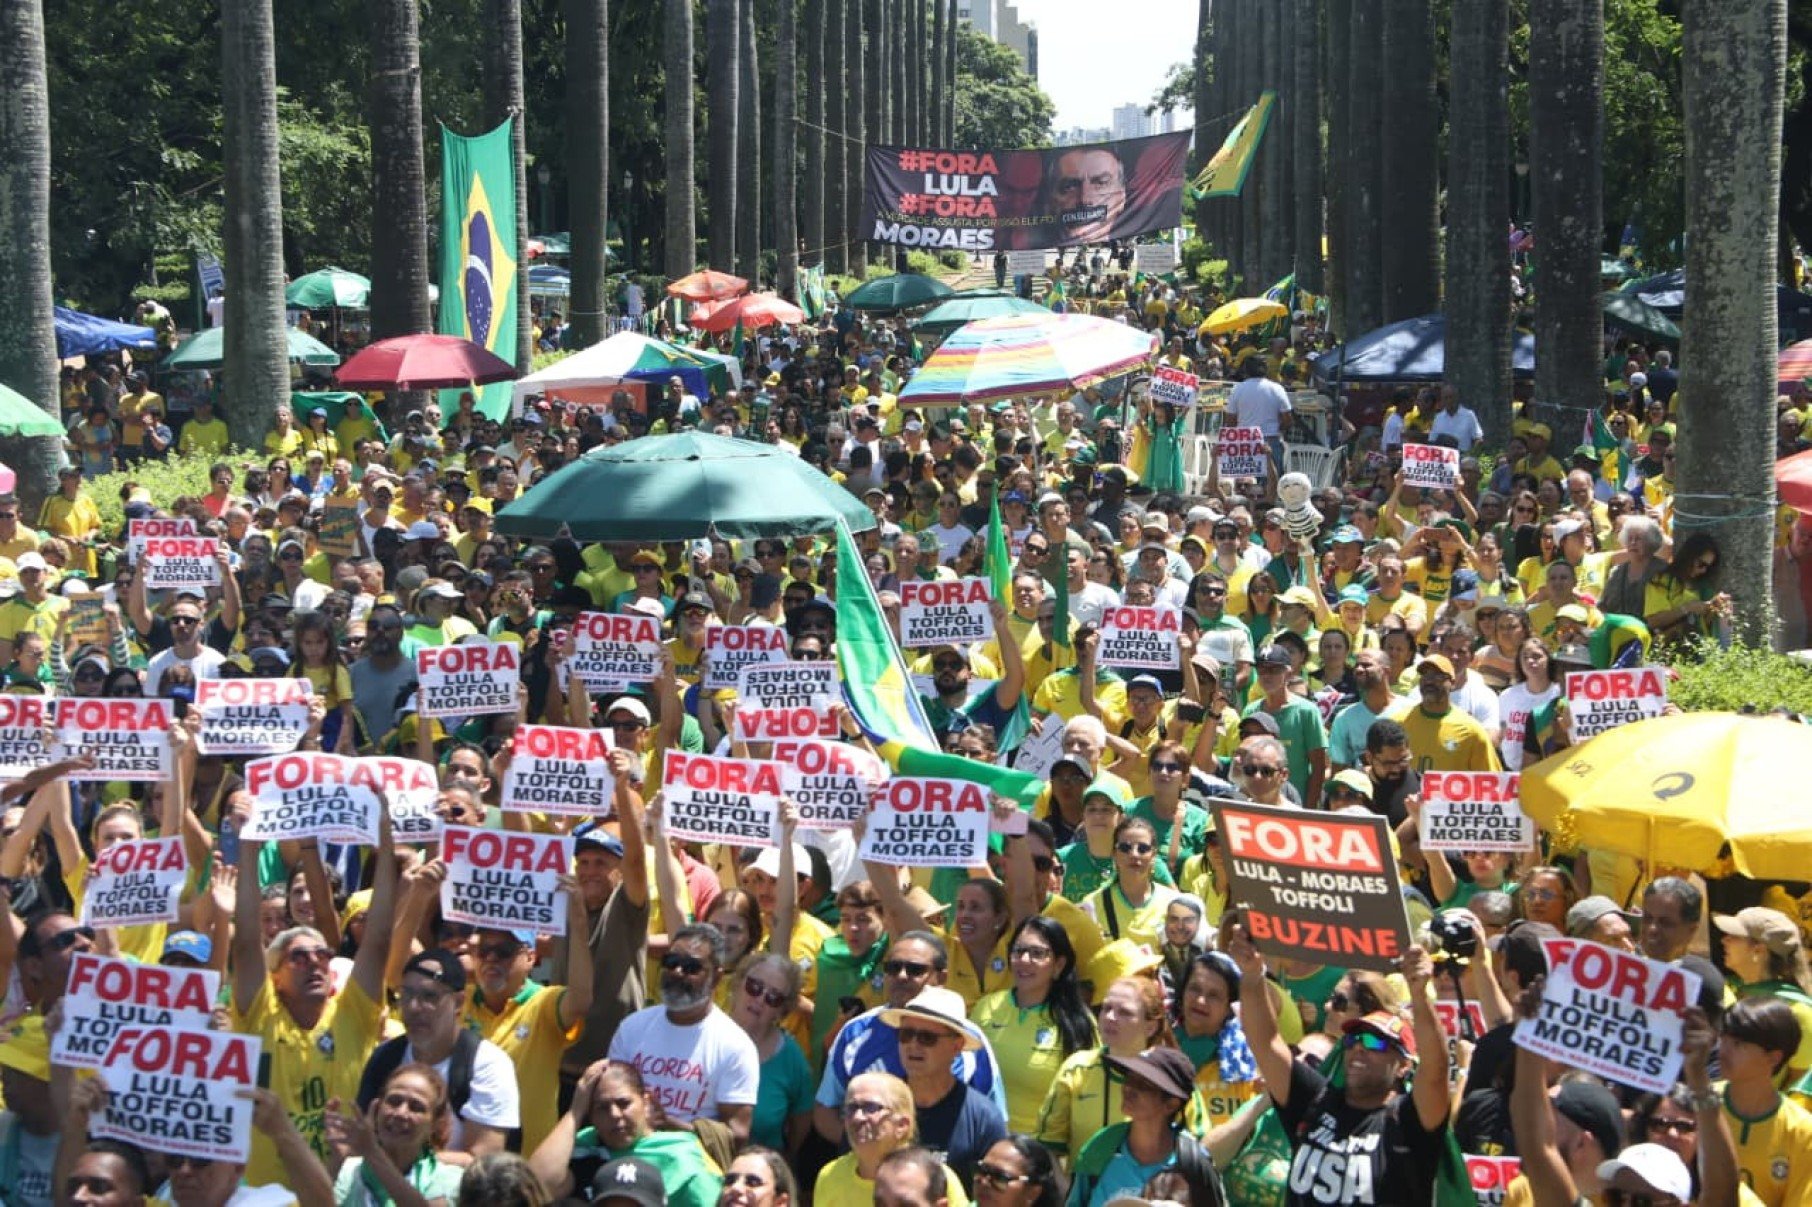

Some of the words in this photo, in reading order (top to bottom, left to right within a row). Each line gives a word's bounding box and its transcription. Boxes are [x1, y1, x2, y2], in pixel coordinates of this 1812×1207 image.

[899, 150, 998, 175] #FORA
[924, 173, 998, 196] LULA
[898, 193, 997, 218] #FORA
[873, 219, 995, 250] MORAES
[1154, 367, 1199, 391] FORA
[1219, 428, 1262, 441] FORA
[1217, 443, 1264, 456] FORA
[1405, 446, 1457, 463] FORA
[132, 520, 193, 537] FORA
[146, 540, 216, 557] FORA
[154, 565, 212, 574] TOFFOLI
[902, 582, 990, 608] FORA
[923, 606, 970, 617] LULA
[1102, 607, 1180, 632] FORA
[572, 613, 658, 643] FORA
[909, 615, 985, 628] TOFFOLI
[707, 627, 787, 651] FORA
[908, 626, 985, 640] MORAES
[1117, 630, 1159, 642] LULA
[591, 641, 637, 652] LULA
[1104, 639, 1172, 652] TOFFOLI
[418, 645, 516, 675] FORA
[578, 650, 654, 664] TOFFOLI
[726, 651, 770, 662] LULA
[1102, 649, 1172, 663] MORAES
[574, 661, 654, 675] MORAES
[748, 670, 831, 684] MORAES
[444, 672, 495, 686] LULA
[1568, 671, 1663, 700] FORA
[199, 681, 309, 706] FORA
[428, 682, 511, 698] TOFFOLI
[745, 683, 831, 696] TOFFOLI
[427, 693, 511, 710] MORAES
[762, 696, 812, 707] LULA
[1591, 700, 1640, 713] LULA
[57, 701, 168, 730] FORA
[224, 705, 282, 719] LULA
[206, 717, 300, 732] TOFFOLI
[737, 708, 839, 738] FORA
[3, 729, 42, 741] ULA
[82, 732, 140, 744] LULA
[203, 731, 297, 745] MORAES
[512, 724, 611, 762] FORA
[99, 759, 160, 771] RAES
[534, 760, 587, 776] LULA
[250, 756, 380, 796] FORA
[516, 773, 604, 792] TOFFOLI
[665, 753, 782, 797] FORA
[801, 777, 857, 791] LULA
[282, 786, 349, 805] LULA
[513, 787, 603, 806] MORAES
[869, 781, 985, 813] FORA
[1422, 773, 1520, 802] FORA
[691, 790, 752, 808] LULA
[260, 799, 368, 822] TOFFOLI
[671, 801, 770, 824] TOFFOLI
[1449, 803, 1503, 815] LULA
[256, 812, 368, 832] MORAES
[670, 816, 770, 839] MORAES
[894, 813, 956, 828] LULA
[1430, 815, 1522, 828] TOFFOLI
[873, 828, 975, 843] TOFFOLI
[1224, 814, 1380, 868] FORA
[1430, 829, 1522, 842] MORAES
[95, 843, 185, 876] FORA
[443, 829, 567, 874] FORA
[871, 842, 975, 858] MORAES
[113, 873, 157, 889] LULA
[473, 868, 534, 889] LULA
[1233, 860, 1282, 884] LULA
[1301, 871, 1389, 895] MORAES
[96, 886, 170, 903] TOFFOLI
[453, 881, 553, 907] TOFFOLI
[1271, 886, 1355, 914] TOFFOLI
[91, 900, 168, 917] MORAES
[452, 897, 553, 923] MORAES
[1248, 911, 1401, 957] BUZINE
[69, 958, 212, 1014] FORA
[1543, 940, 1688, 1018] FORA
[101, 1003, 173, 1025] LULA
[1572, 989, 1648, 1029] LULA
[1543, 999, 1670, 1057] TOFFOLI
[103, 1028, 251, 1084] FORA
[1534, 1019, 1665, 1076] MORAES
[131, 1073, 209, 1101] LULA
[302, 1076, 325, 1112] 10
[107, 1091, 235, 1124] TOFFOLI
[105, 1108, 233, 1144] MORAES
[1290, 1144, 1375, 1205] USA
